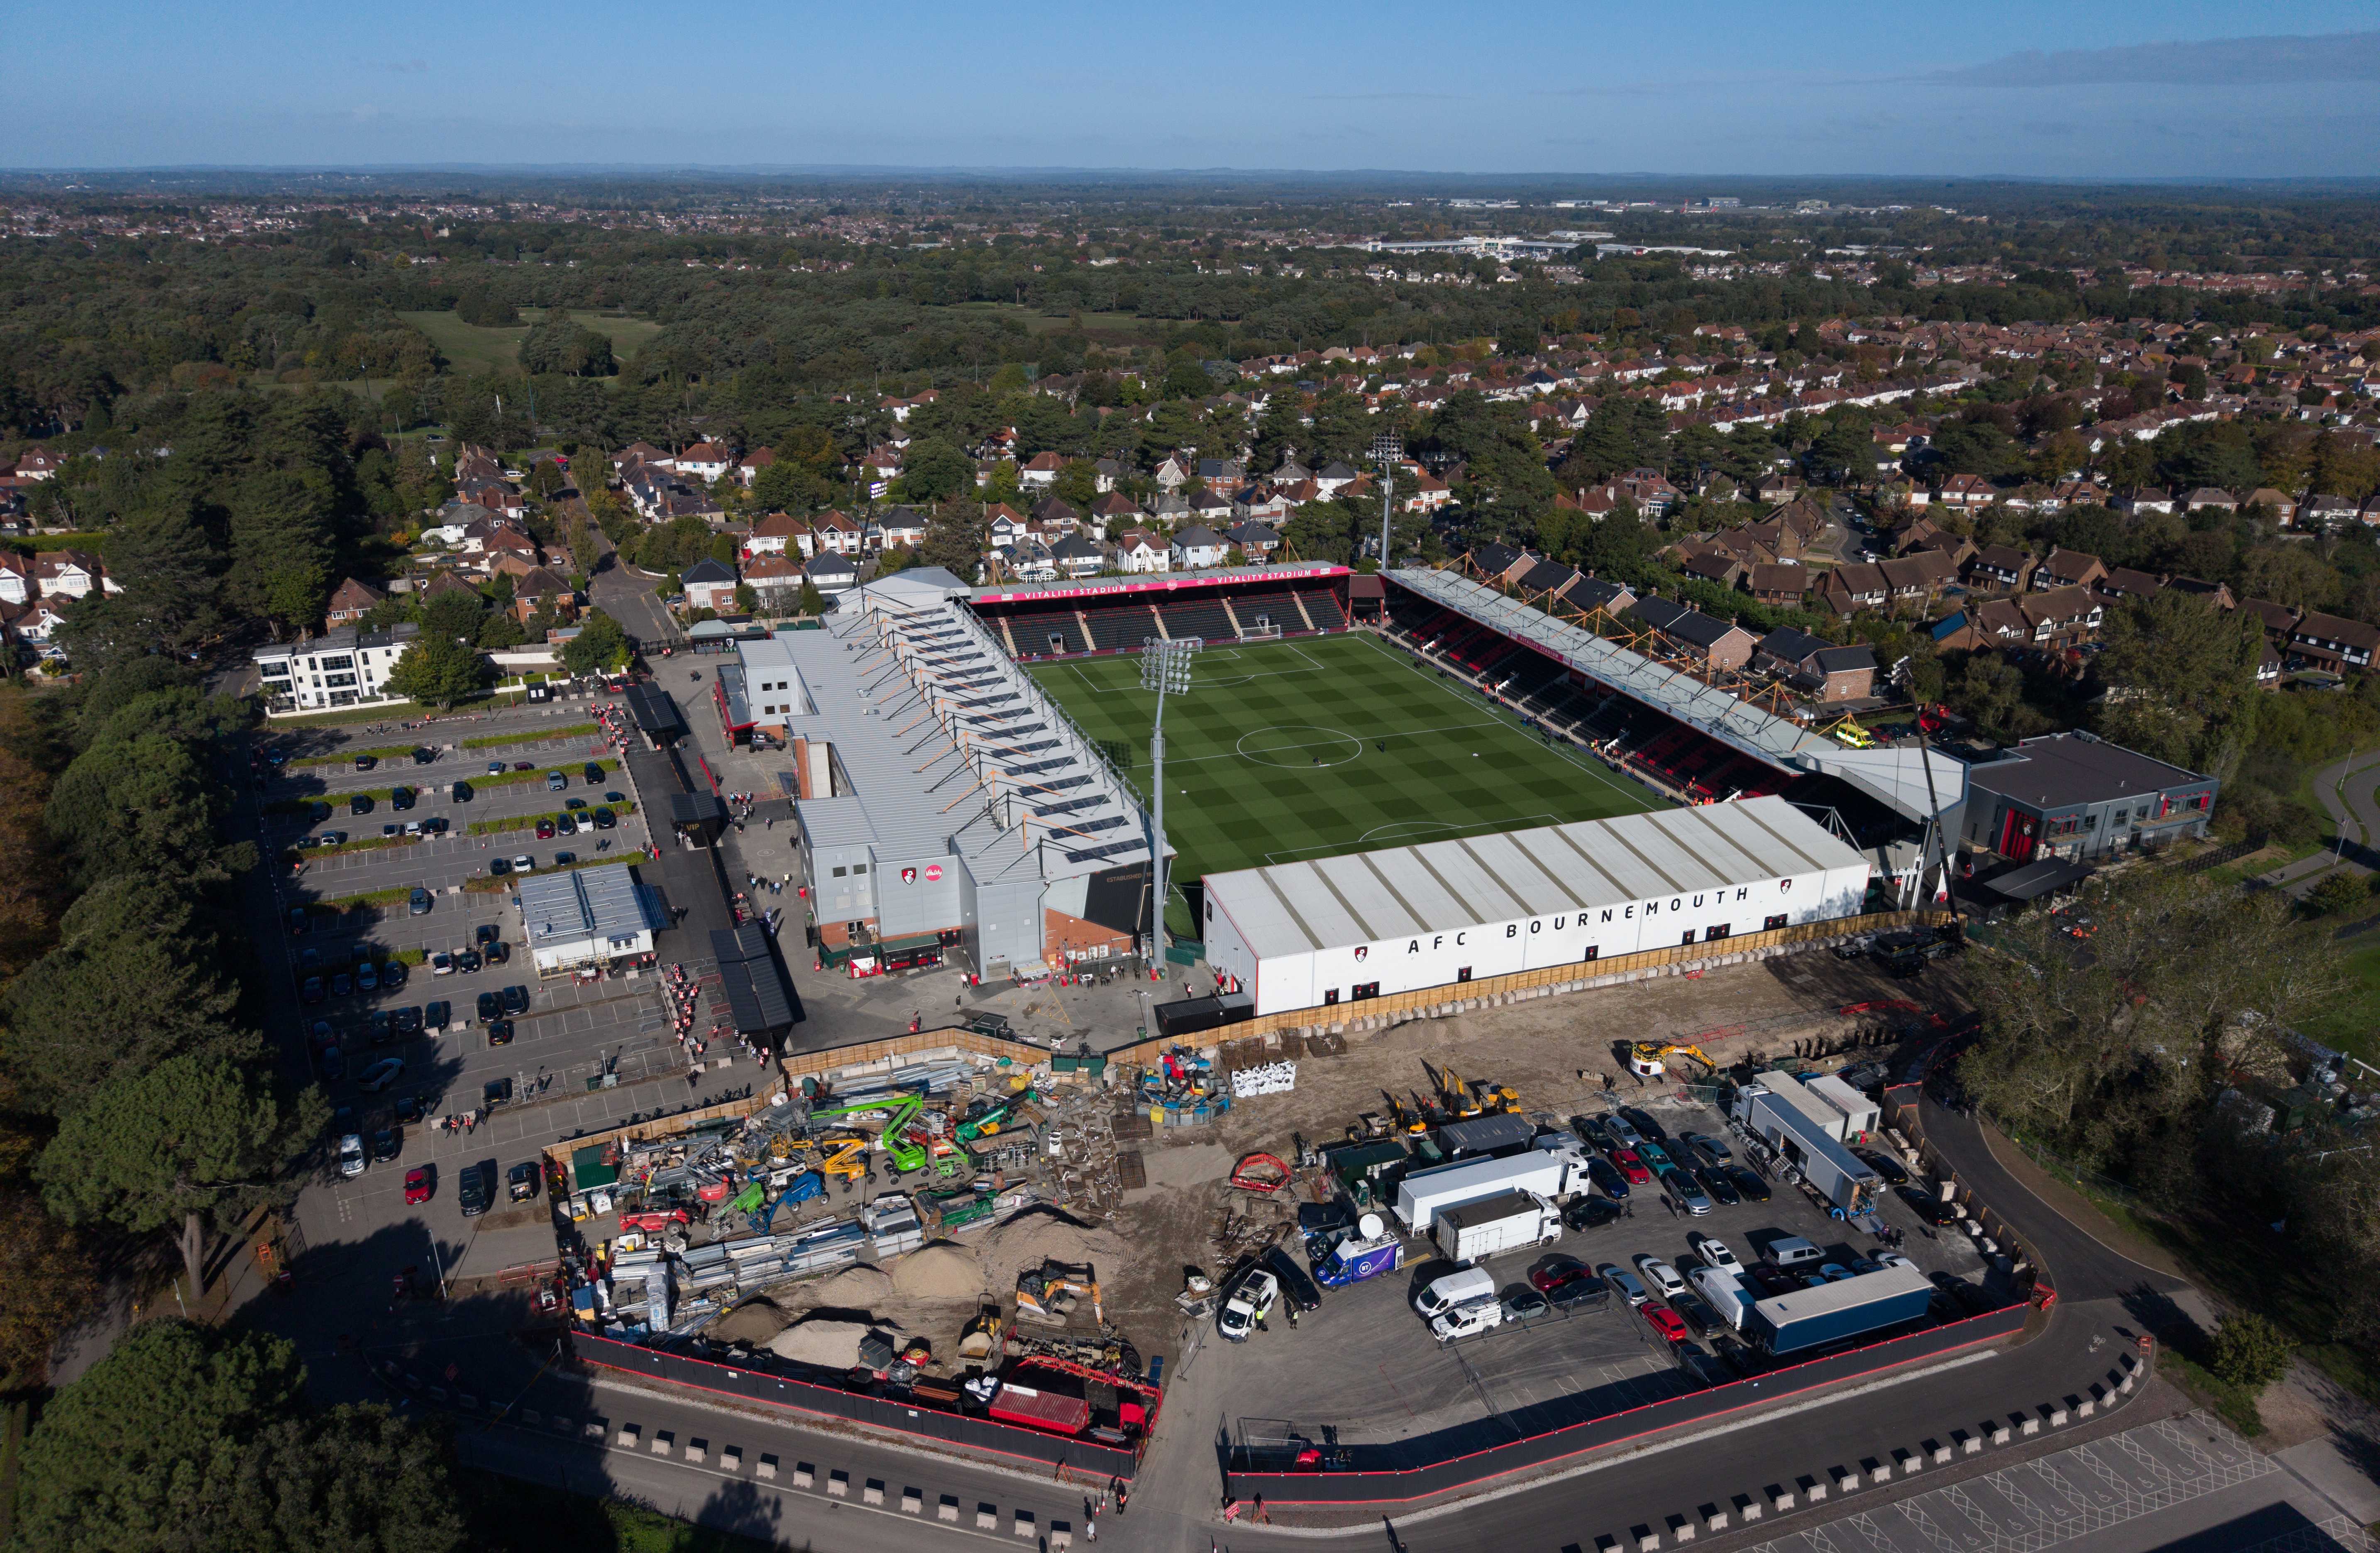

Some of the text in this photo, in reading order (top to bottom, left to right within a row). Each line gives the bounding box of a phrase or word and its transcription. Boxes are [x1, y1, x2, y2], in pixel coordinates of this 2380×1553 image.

[1217, 570, 1311, 583] VITALITY STADIUM
[1025, 589, 1074, 598] VITALITY
[1080, 586, 1126, 595] STADIUM
[1520, 636, 1558, 658] VITALITY STADIUM
[1107, 873, 1141, 882] ESTABLISHED
[1408, 887, 1747, 954] AFC BOURNEMOUTH
[1226, 1503, 1237, 1513] CAUTION
